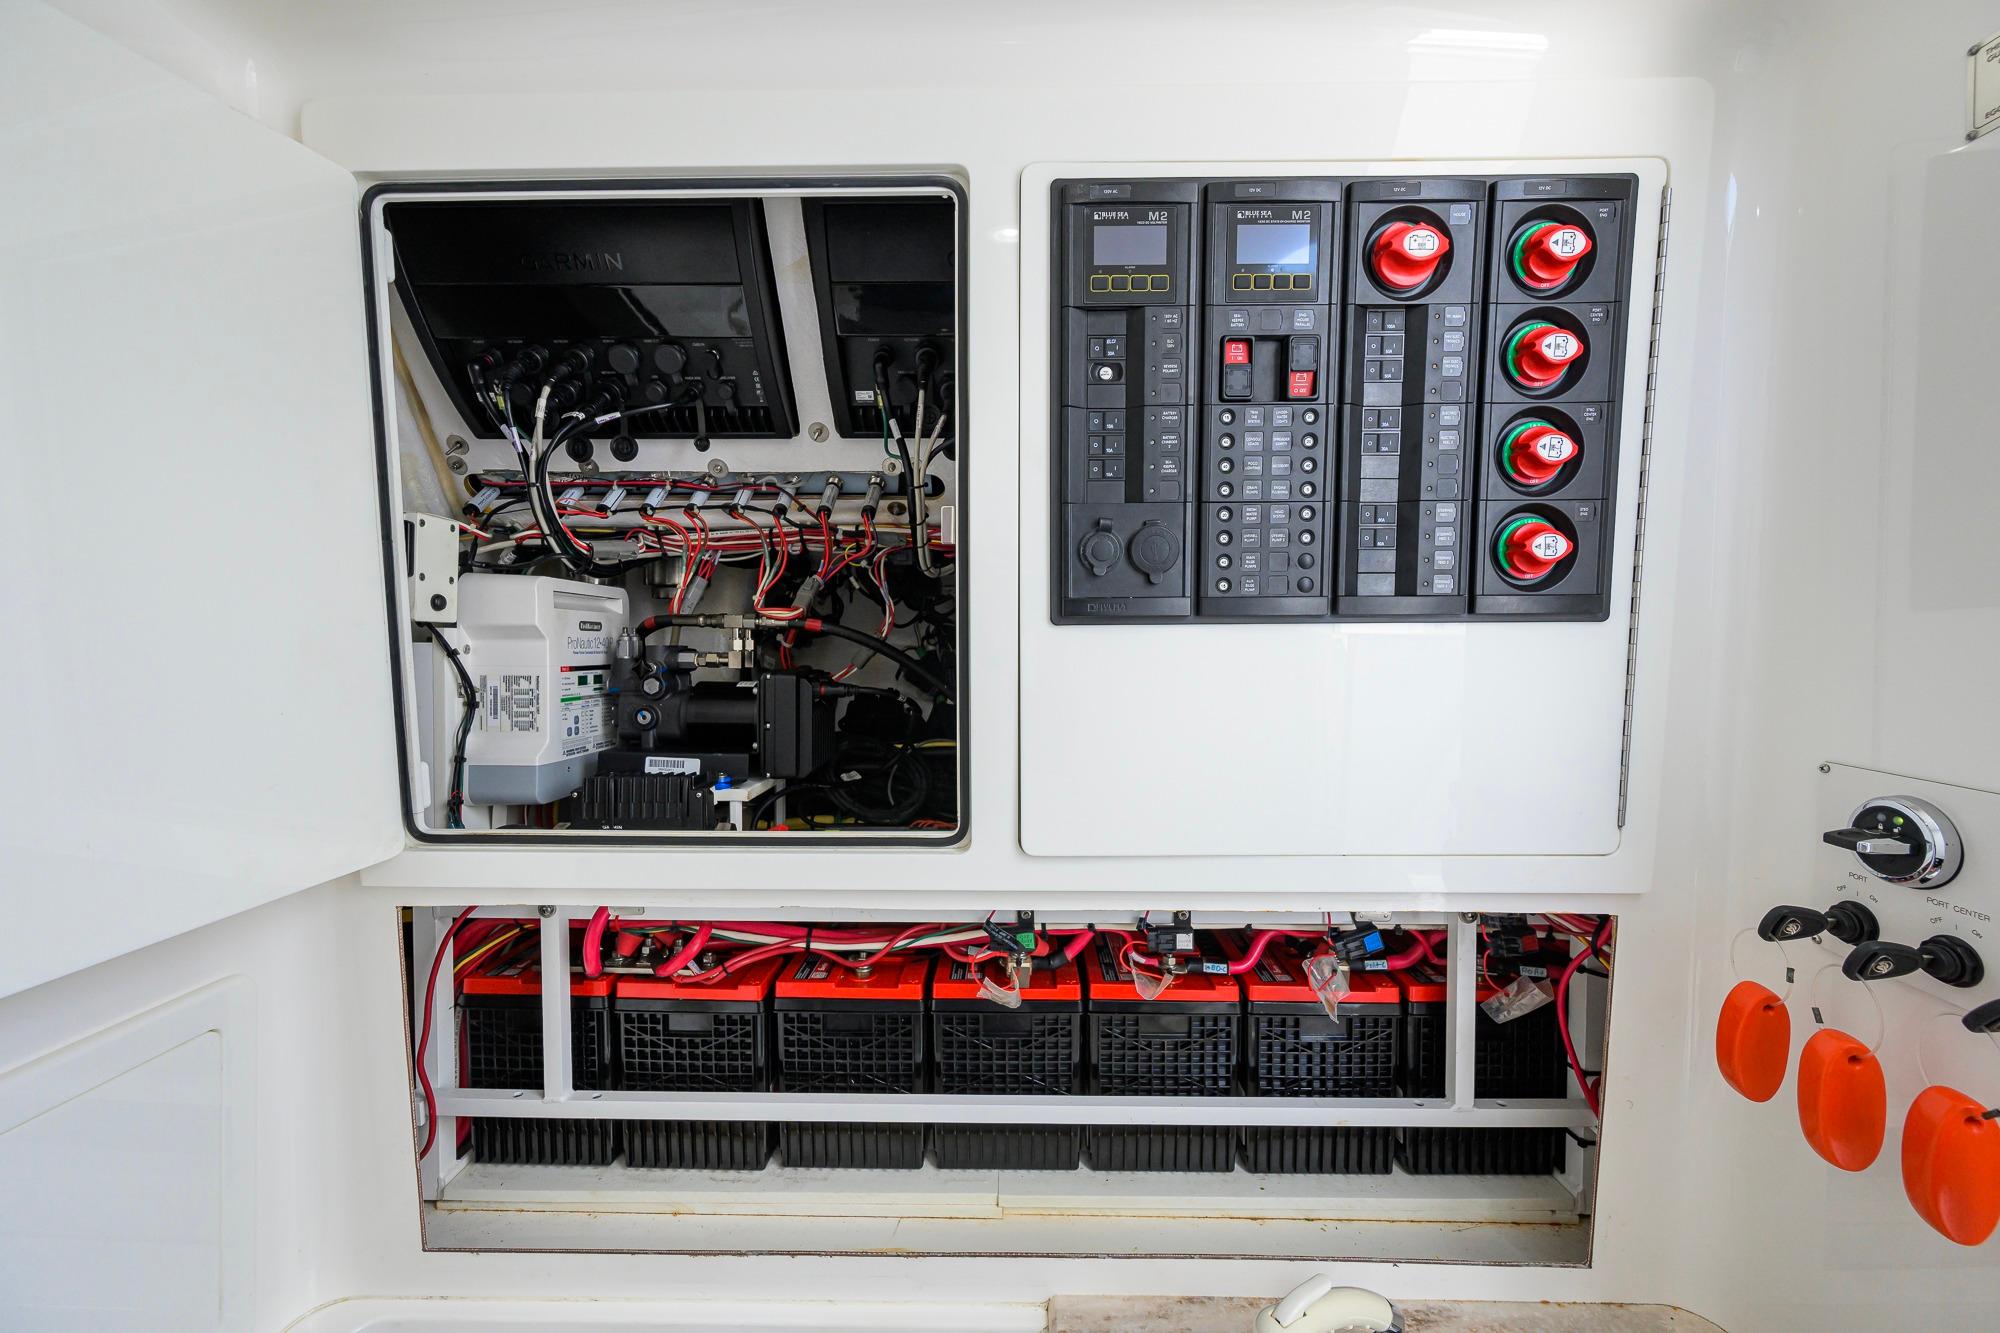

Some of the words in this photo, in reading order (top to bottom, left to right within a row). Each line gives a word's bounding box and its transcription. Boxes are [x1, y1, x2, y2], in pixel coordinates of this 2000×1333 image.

[1148, 211, 1168, 220] M2
[1292, 210, 1311, 220] M2
[1848, 871, 1868, 882] PORT
[1926, 896, 1950, 910] PORT
[1953, 905, 1991, 922] CENTER
